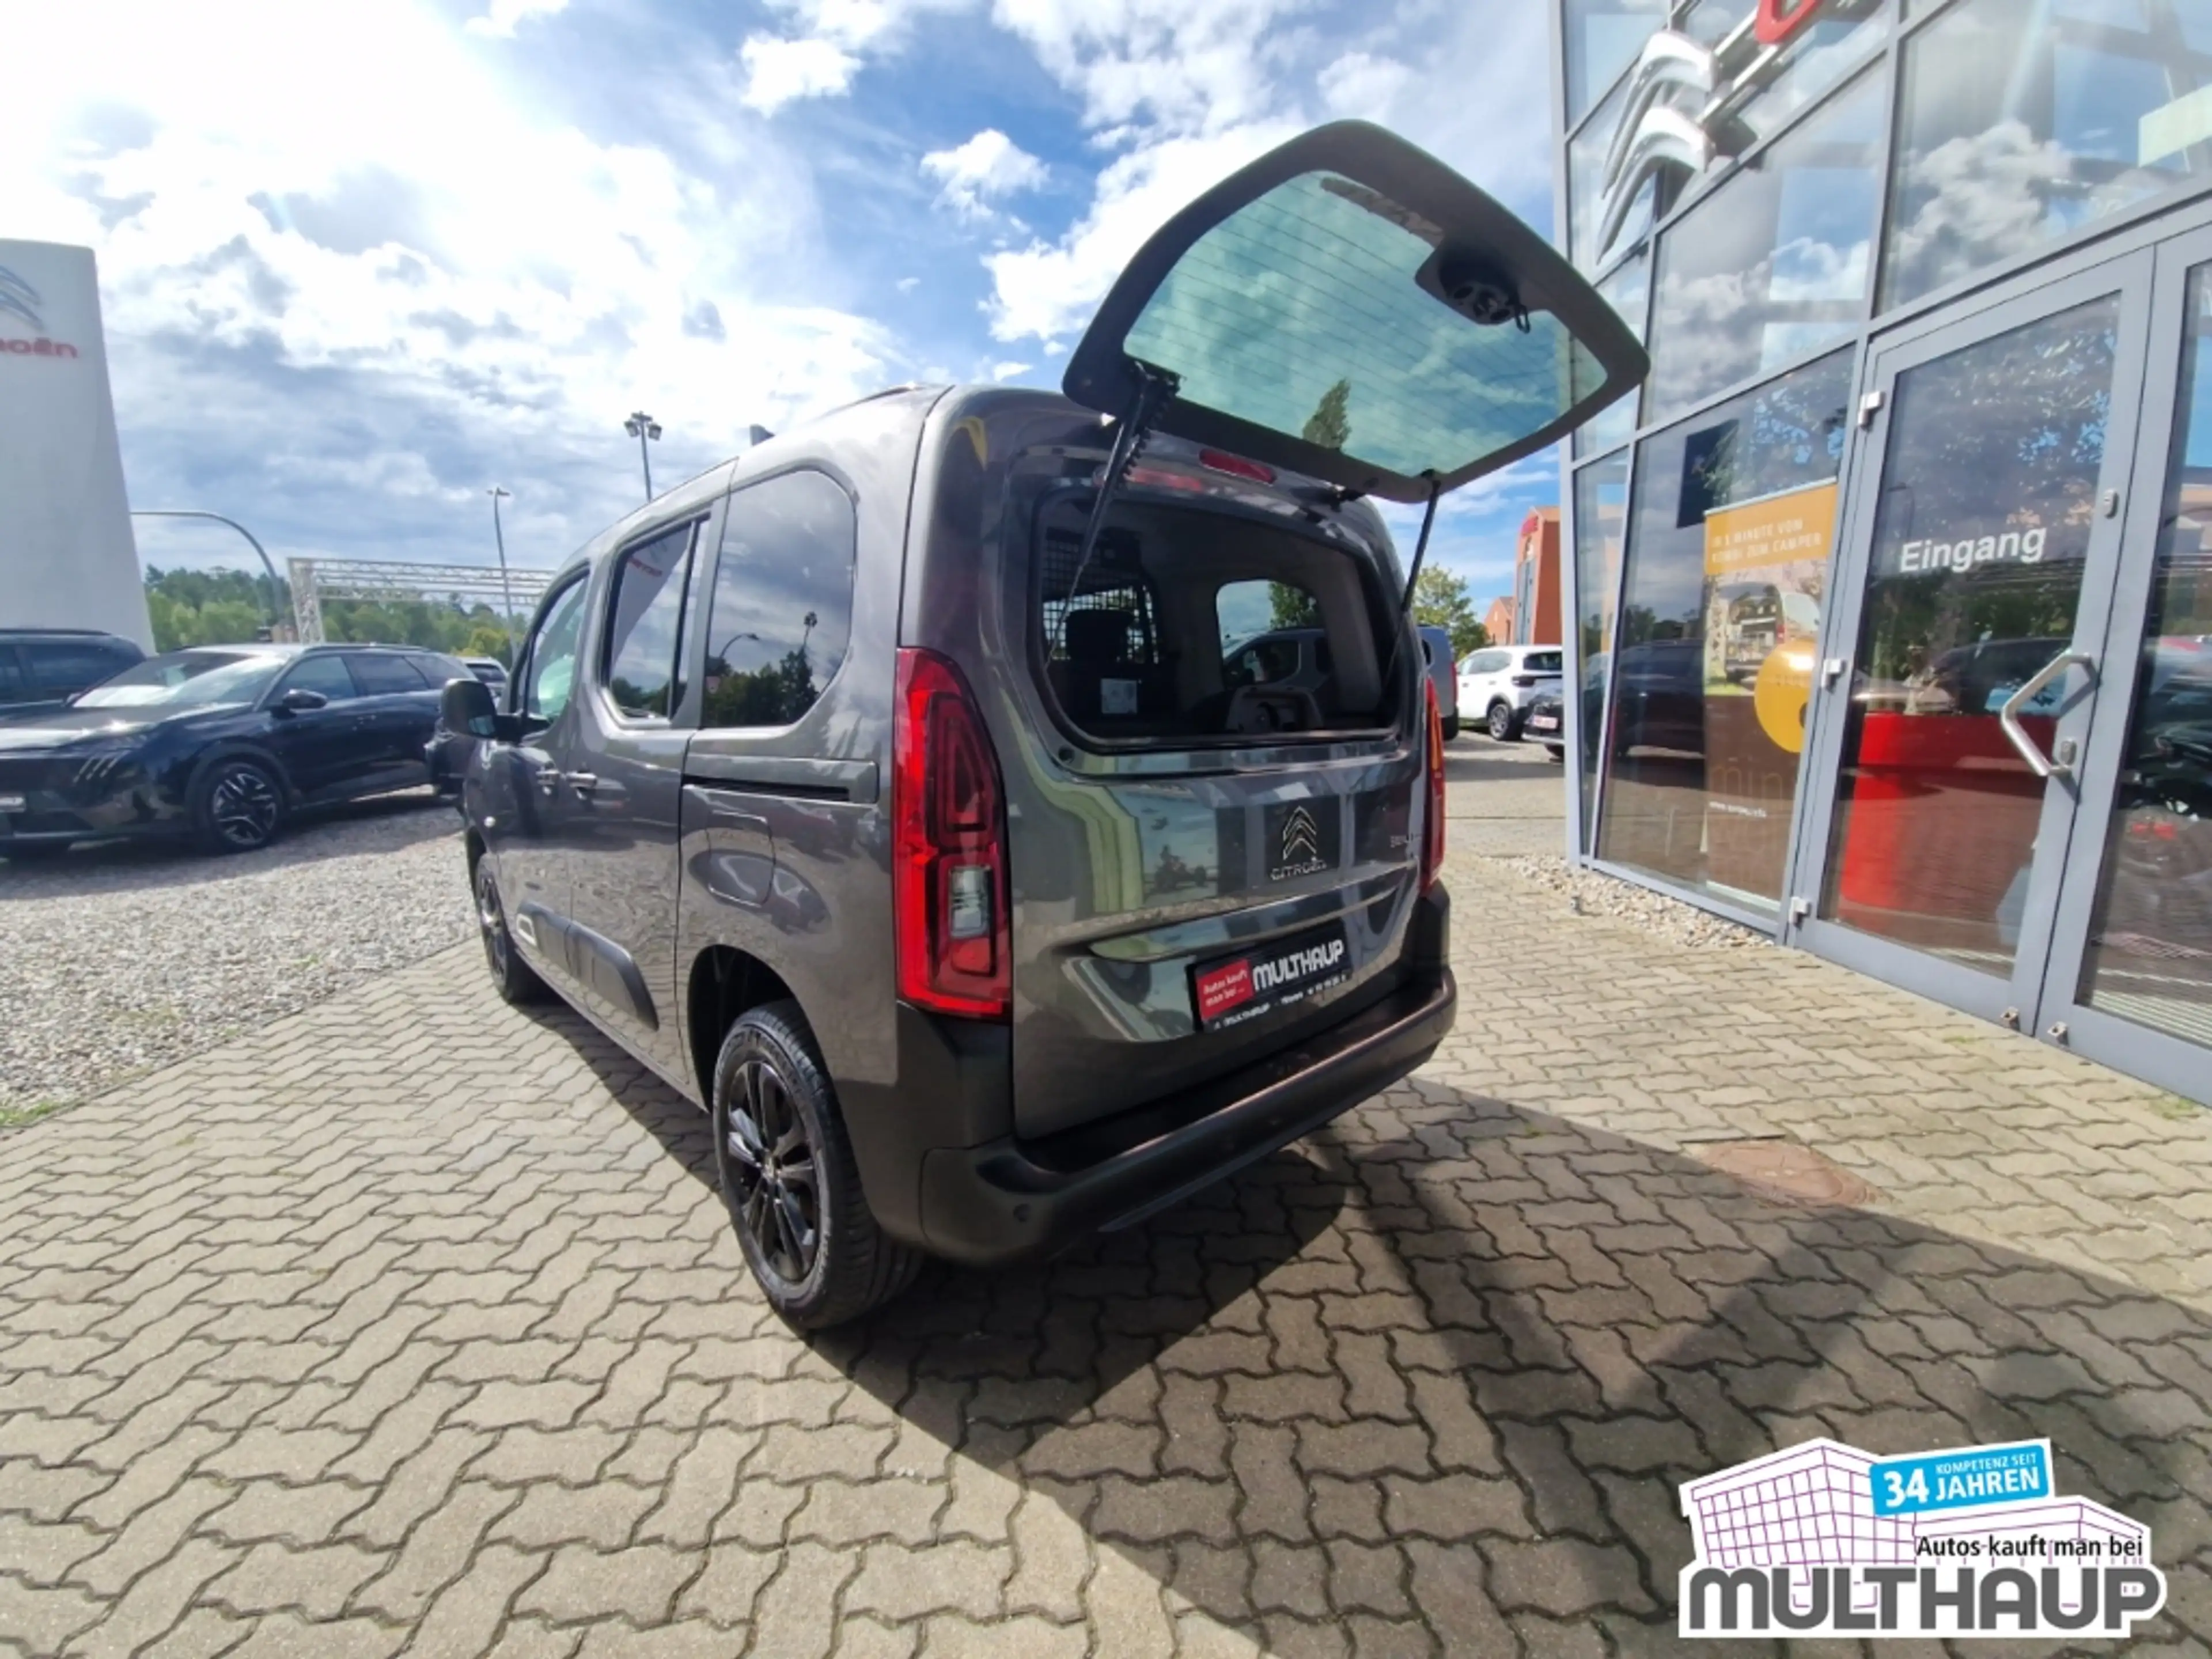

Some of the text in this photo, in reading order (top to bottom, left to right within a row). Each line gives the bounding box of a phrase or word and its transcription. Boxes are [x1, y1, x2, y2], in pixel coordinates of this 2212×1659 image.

[1772, 532, 1823, 552] CAMPER
[1900, 527, 2047, 573] Eingang
[1252, 939, 1345, 993] MULTHAUP
